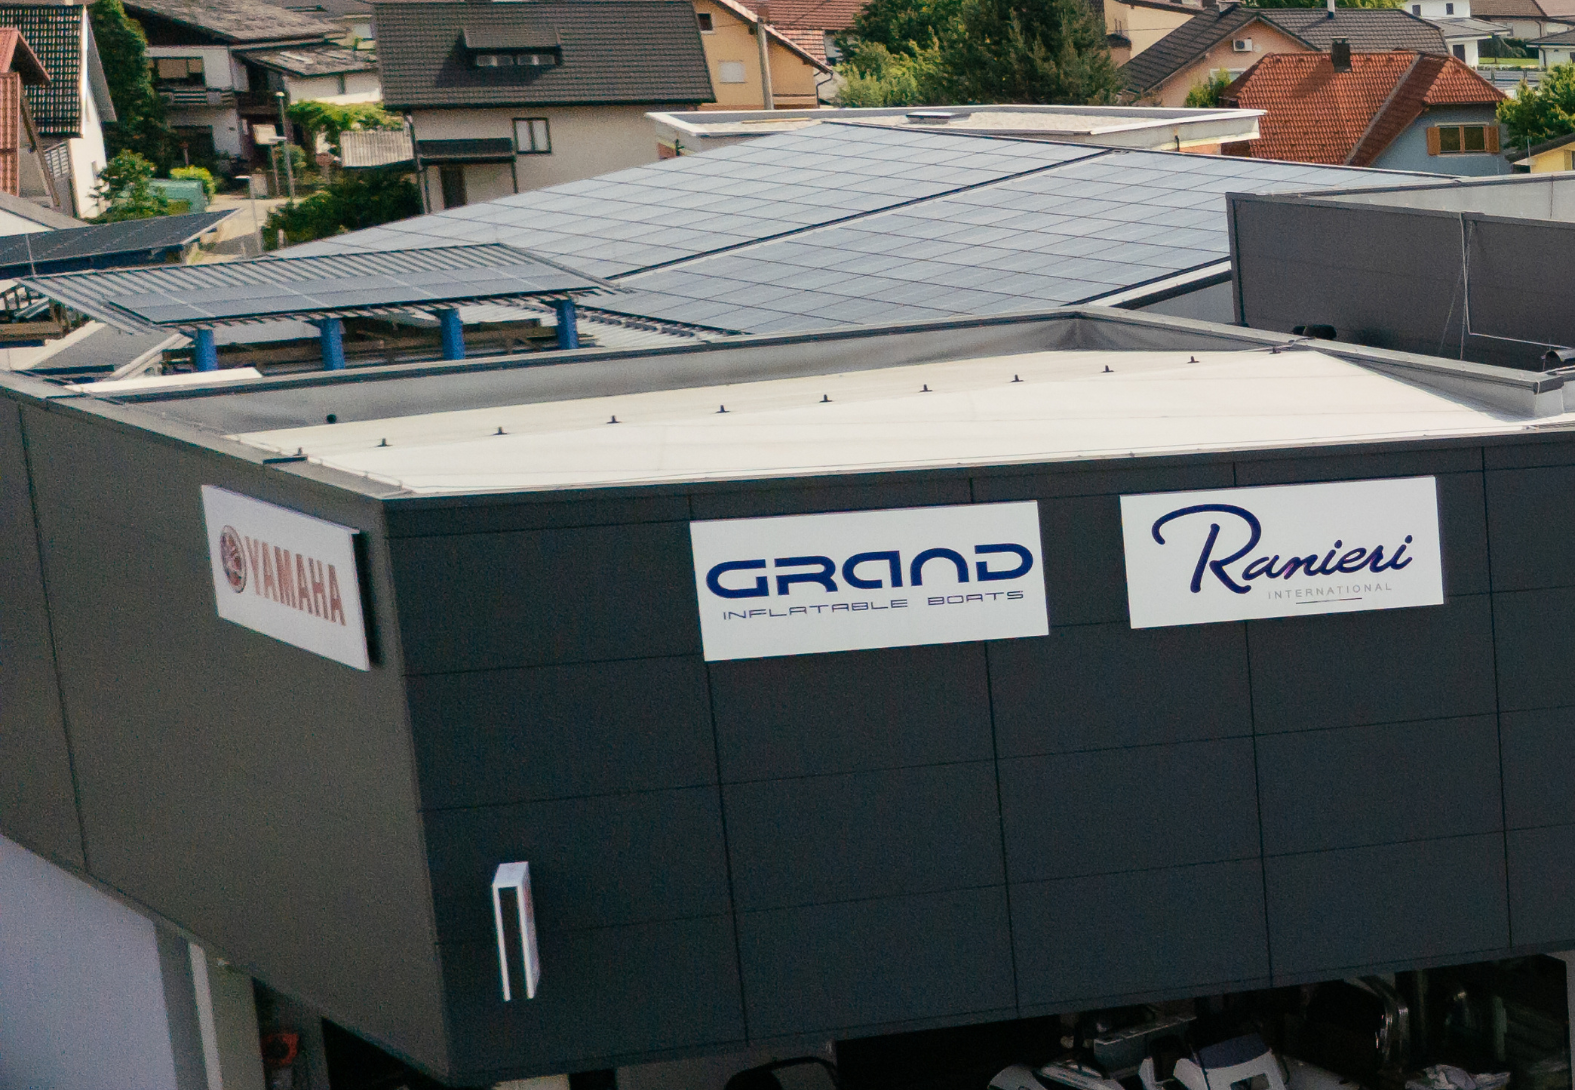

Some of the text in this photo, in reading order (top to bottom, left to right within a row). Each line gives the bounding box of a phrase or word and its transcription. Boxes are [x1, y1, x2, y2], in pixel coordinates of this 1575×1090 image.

[706, 543, 1034, 599] GRAND
[1152, 504, 1413, 594] Ranieri
[245, 535, 346, 626] YAMAHA
[723, 590, 1024, 620] INFLATABLE BOATS
[1268, 583, 1393, 600] INTERNATIONAL
